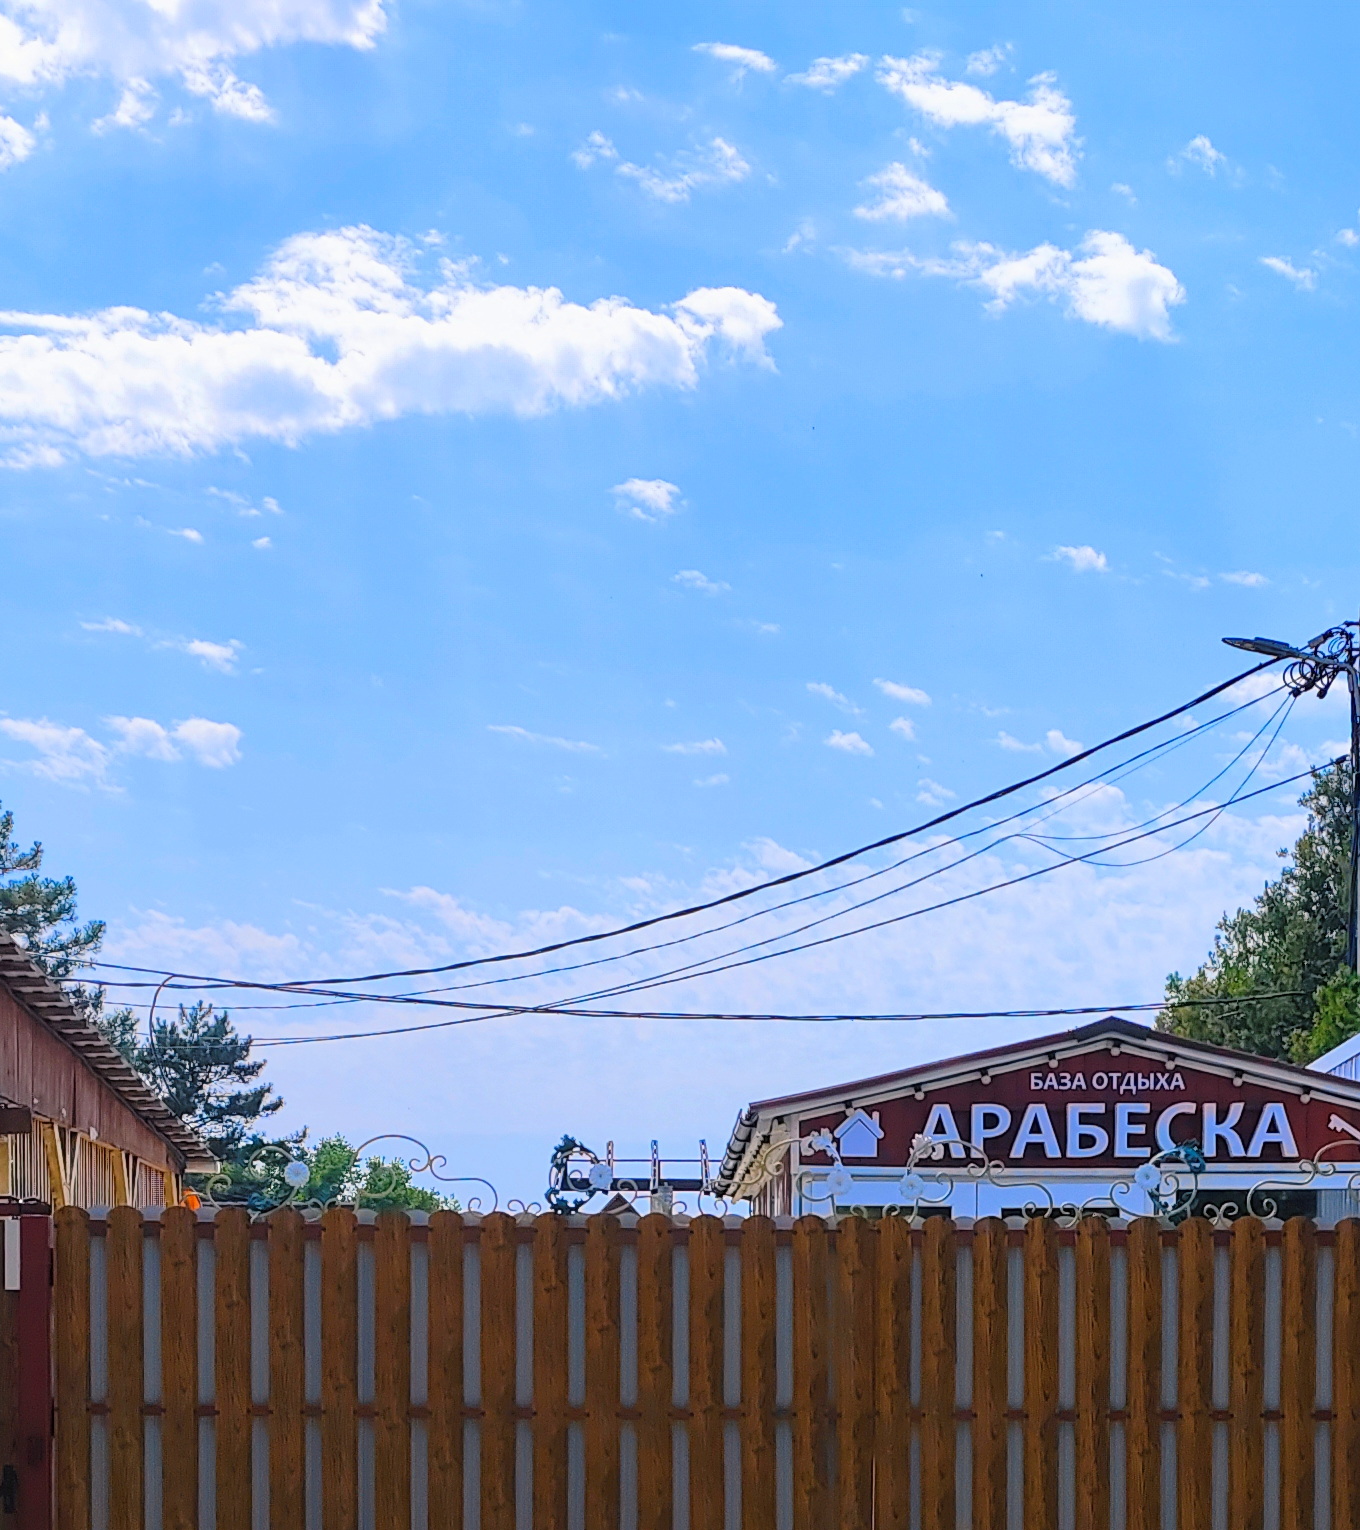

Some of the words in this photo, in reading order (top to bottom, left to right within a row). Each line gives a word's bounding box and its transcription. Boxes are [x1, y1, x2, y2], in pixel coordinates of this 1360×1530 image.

[1030, 1072, 1087, 1091] БАЗА
[1092, 1072, 1186, 1095] ОТДЫХА
[923, 1102, 1300, 1160] АРАБЕСКА
